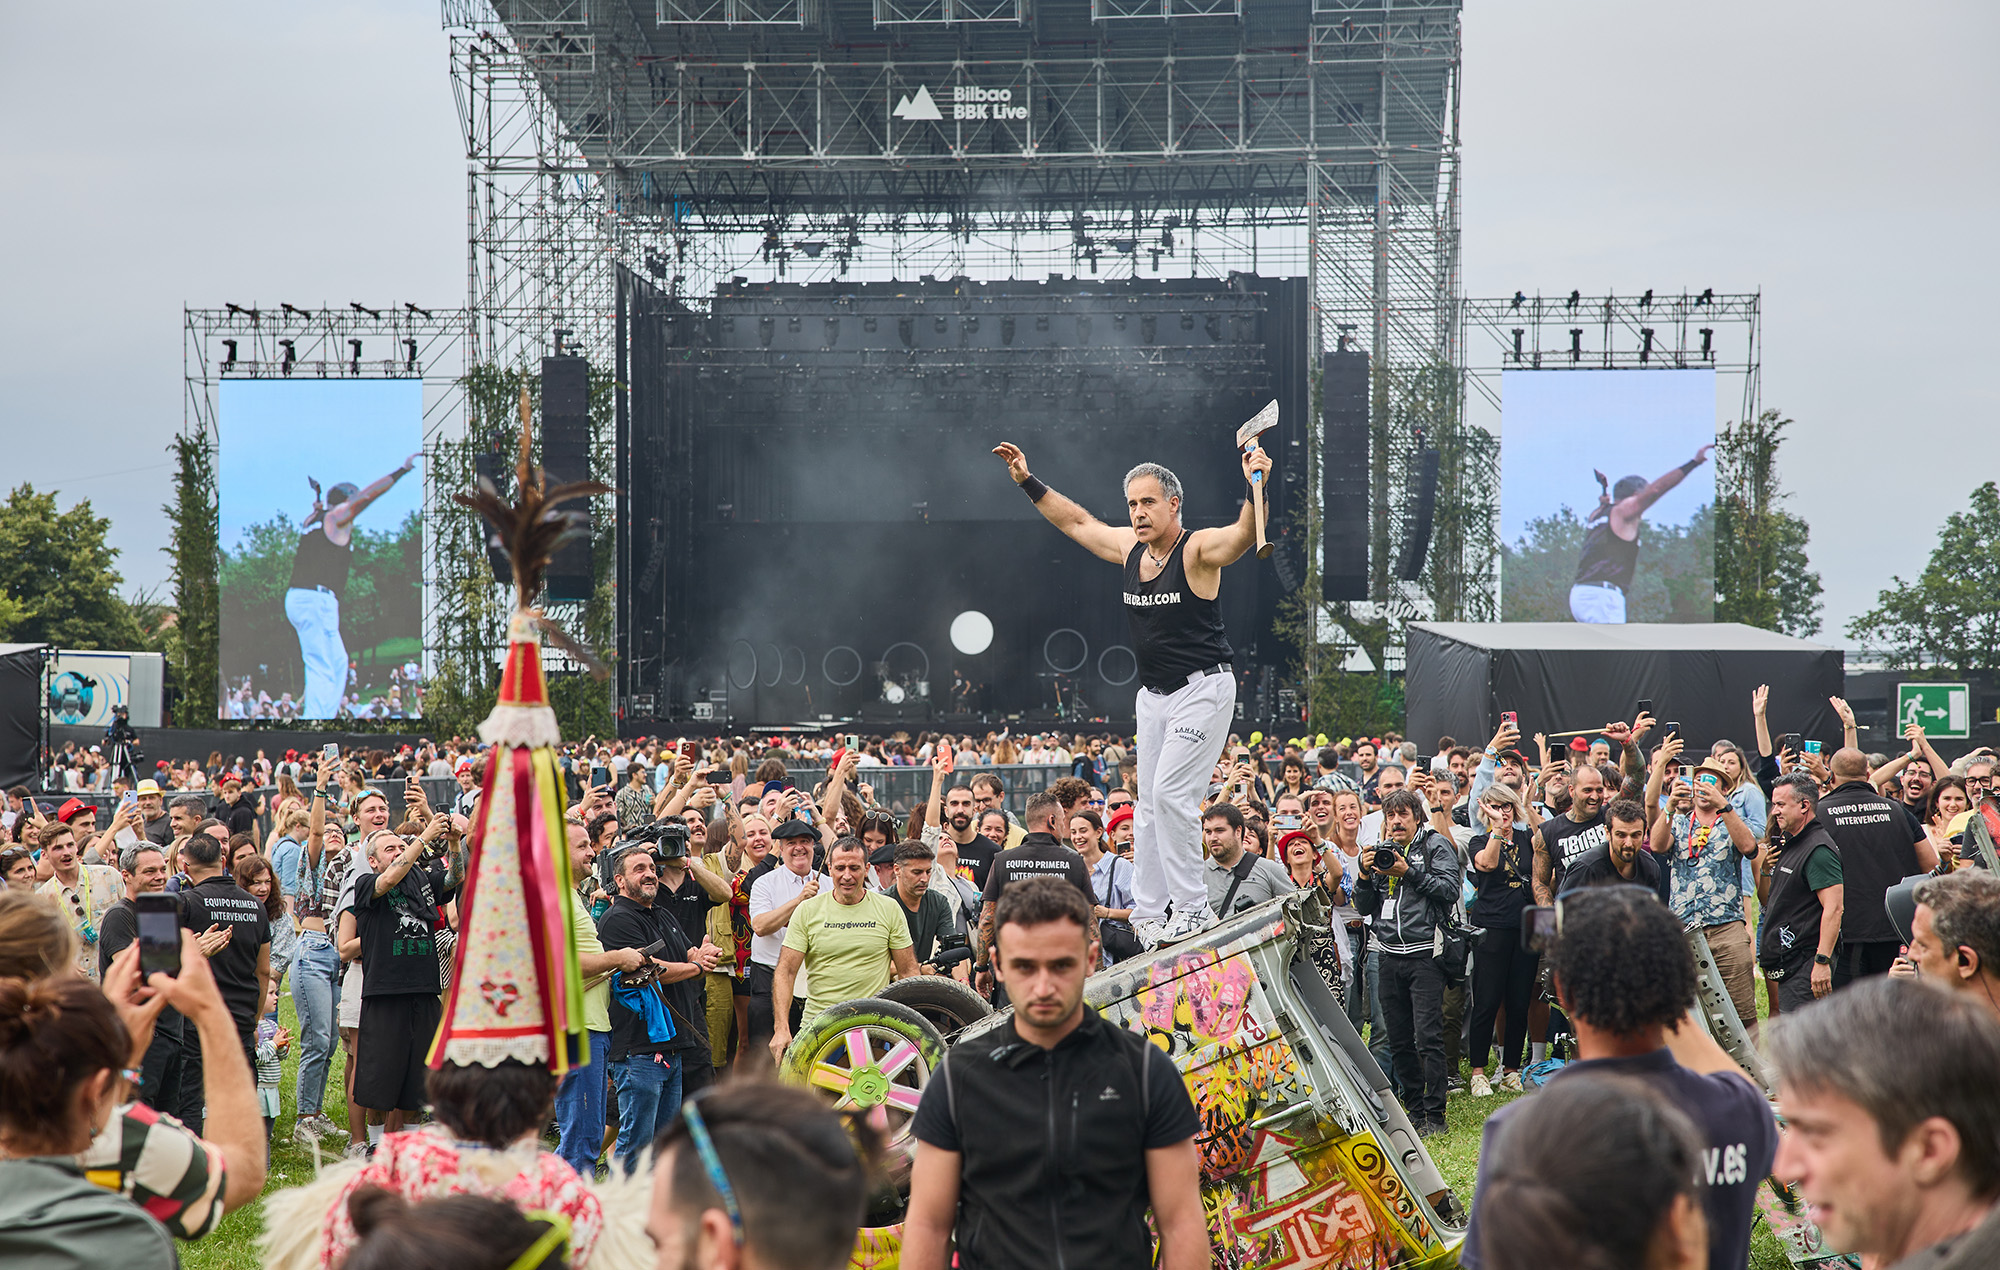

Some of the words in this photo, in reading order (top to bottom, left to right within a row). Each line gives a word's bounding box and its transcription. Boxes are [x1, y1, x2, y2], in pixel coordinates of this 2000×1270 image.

[954, 86, 1012, 102] Bilbao
[953, 104, 988, 120] BBK
[993, 105, 1028, 120] Live
[542, 660, 566, 672] BBK
[1827, 804, 1858, 816] EQUIPO
[1858, 802, 1892, 812] PRIMERA
[1835, 813, 1891, 826] INTERVENCION
[1005, 860, 1035, 869] EQUIPO
[1035, 860, 1070, 870] PRIMERA
[204, 898, 231, 908] EQUIPO
[230, 899, 259, 910] PRIMERA
[210, 911, 258, 923] INTERVENCION
